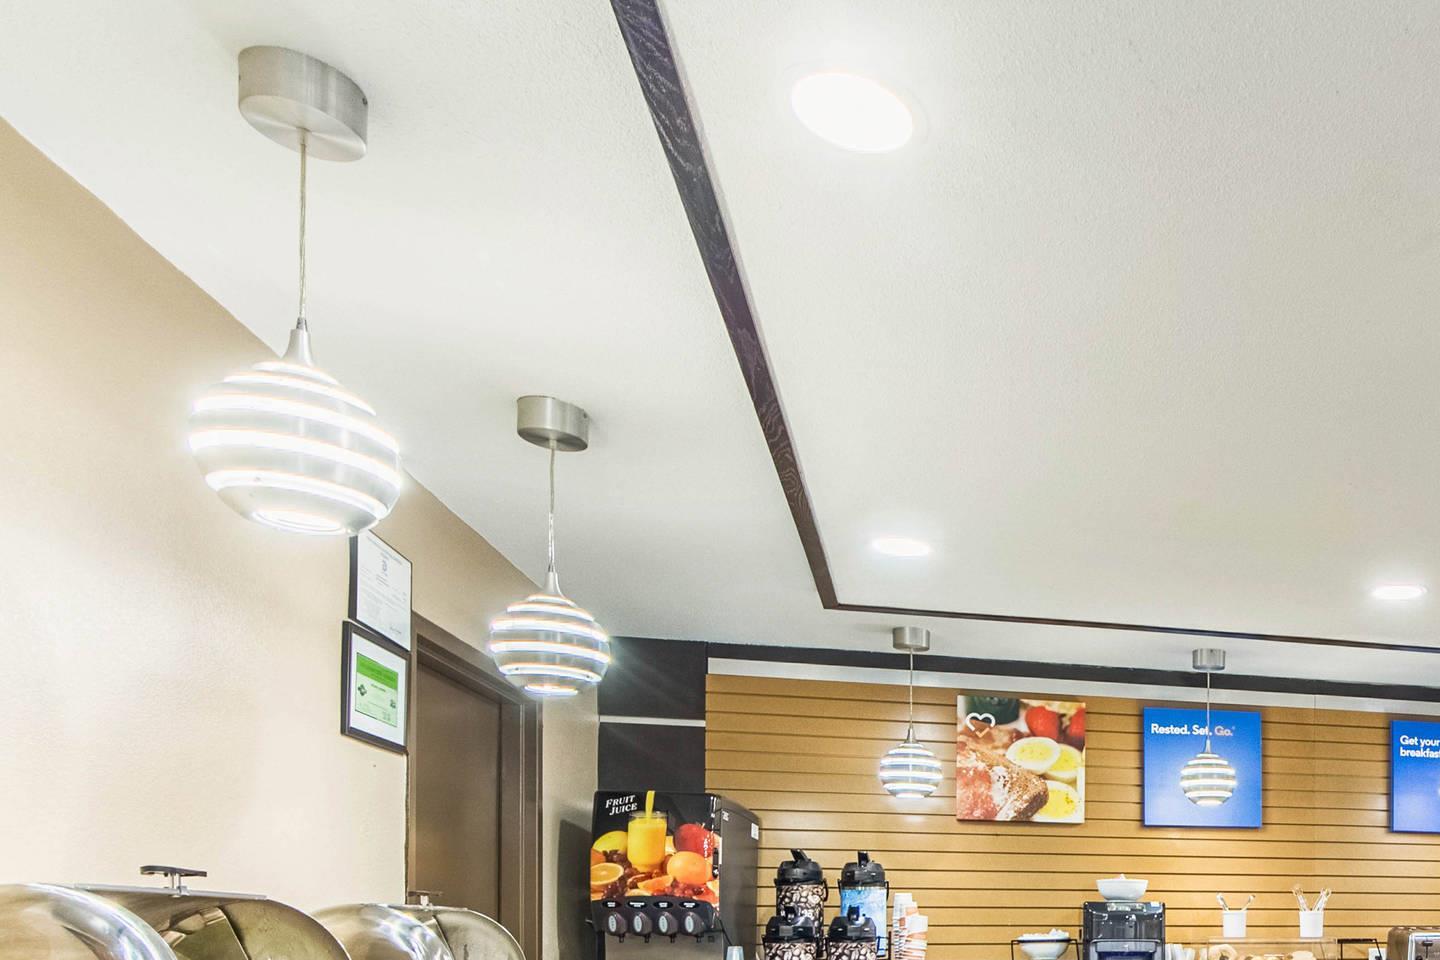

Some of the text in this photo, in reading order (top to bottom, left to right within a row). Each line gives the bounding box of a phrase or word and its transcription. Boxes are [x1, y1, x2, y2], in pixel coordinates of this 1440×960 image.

[1151, 723, 1190, 735] Rested.
[1191, 724, 1212, 736] Set.
[1399, 735, 1440, 748] Get your
[605, 794, 636, 809] FRUIT
[609, 802, 638, 816] JUICE
